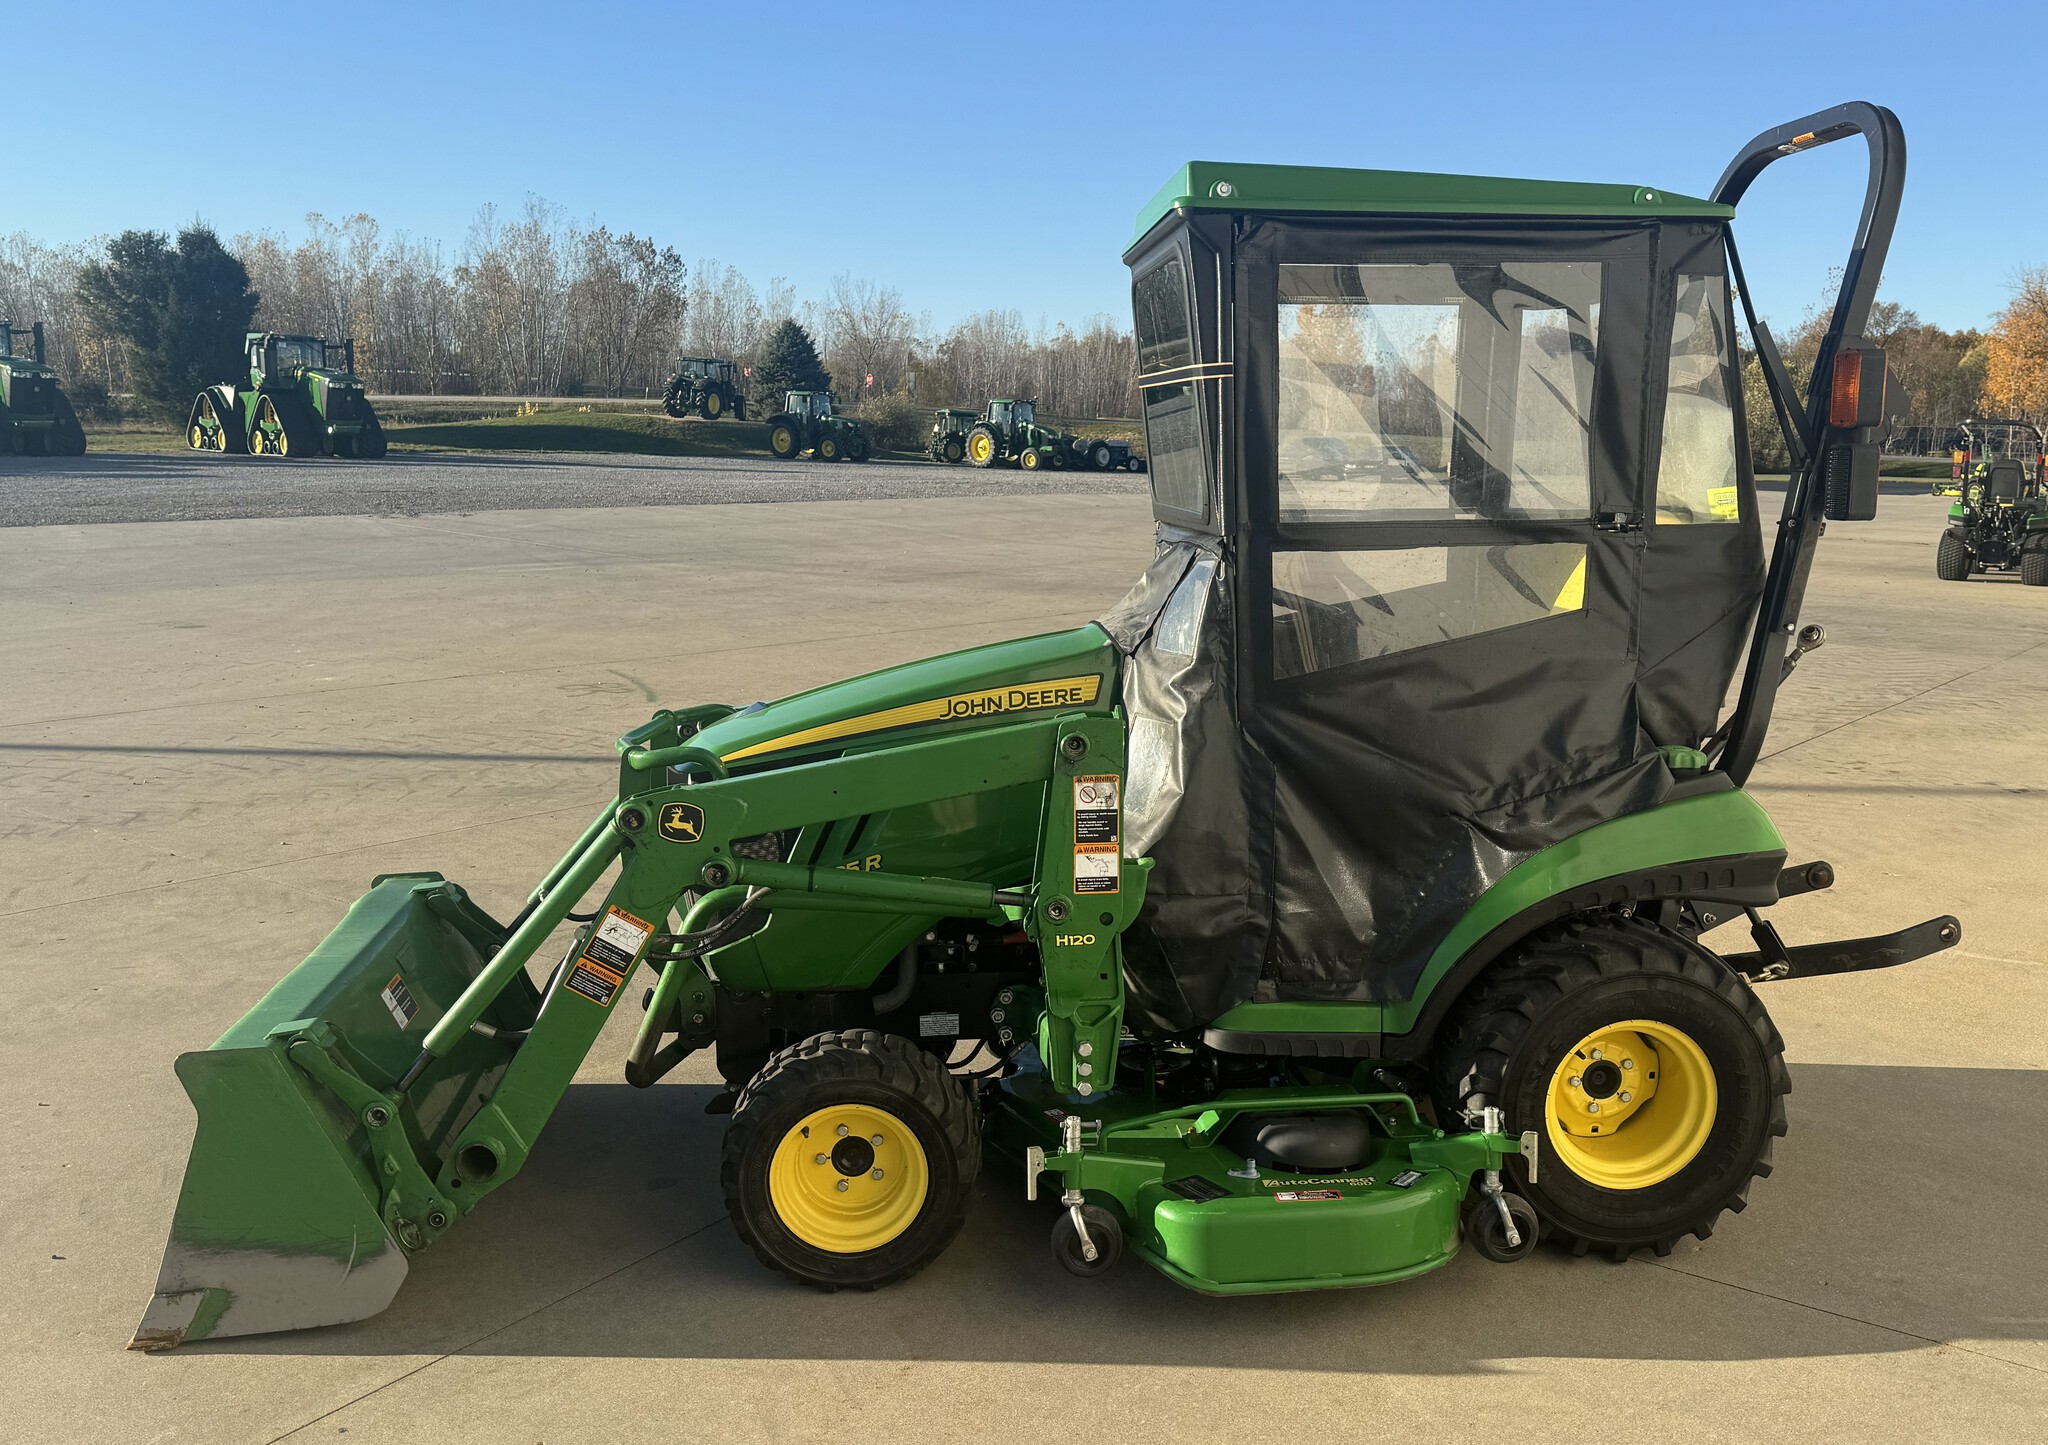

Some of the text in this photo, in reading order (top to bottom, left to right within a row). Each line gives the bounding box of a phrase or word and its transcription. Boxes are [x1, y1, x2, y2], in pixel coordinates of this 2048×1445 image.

[938, 687, 1083, 719] JOHN DEERE
[1082, 775, 1117, 783] WARNING
[620, 911, 650, 930] WARNING
[1055, 933, 1096, 947] H120
[589, 965, 618, 983] WARNING
